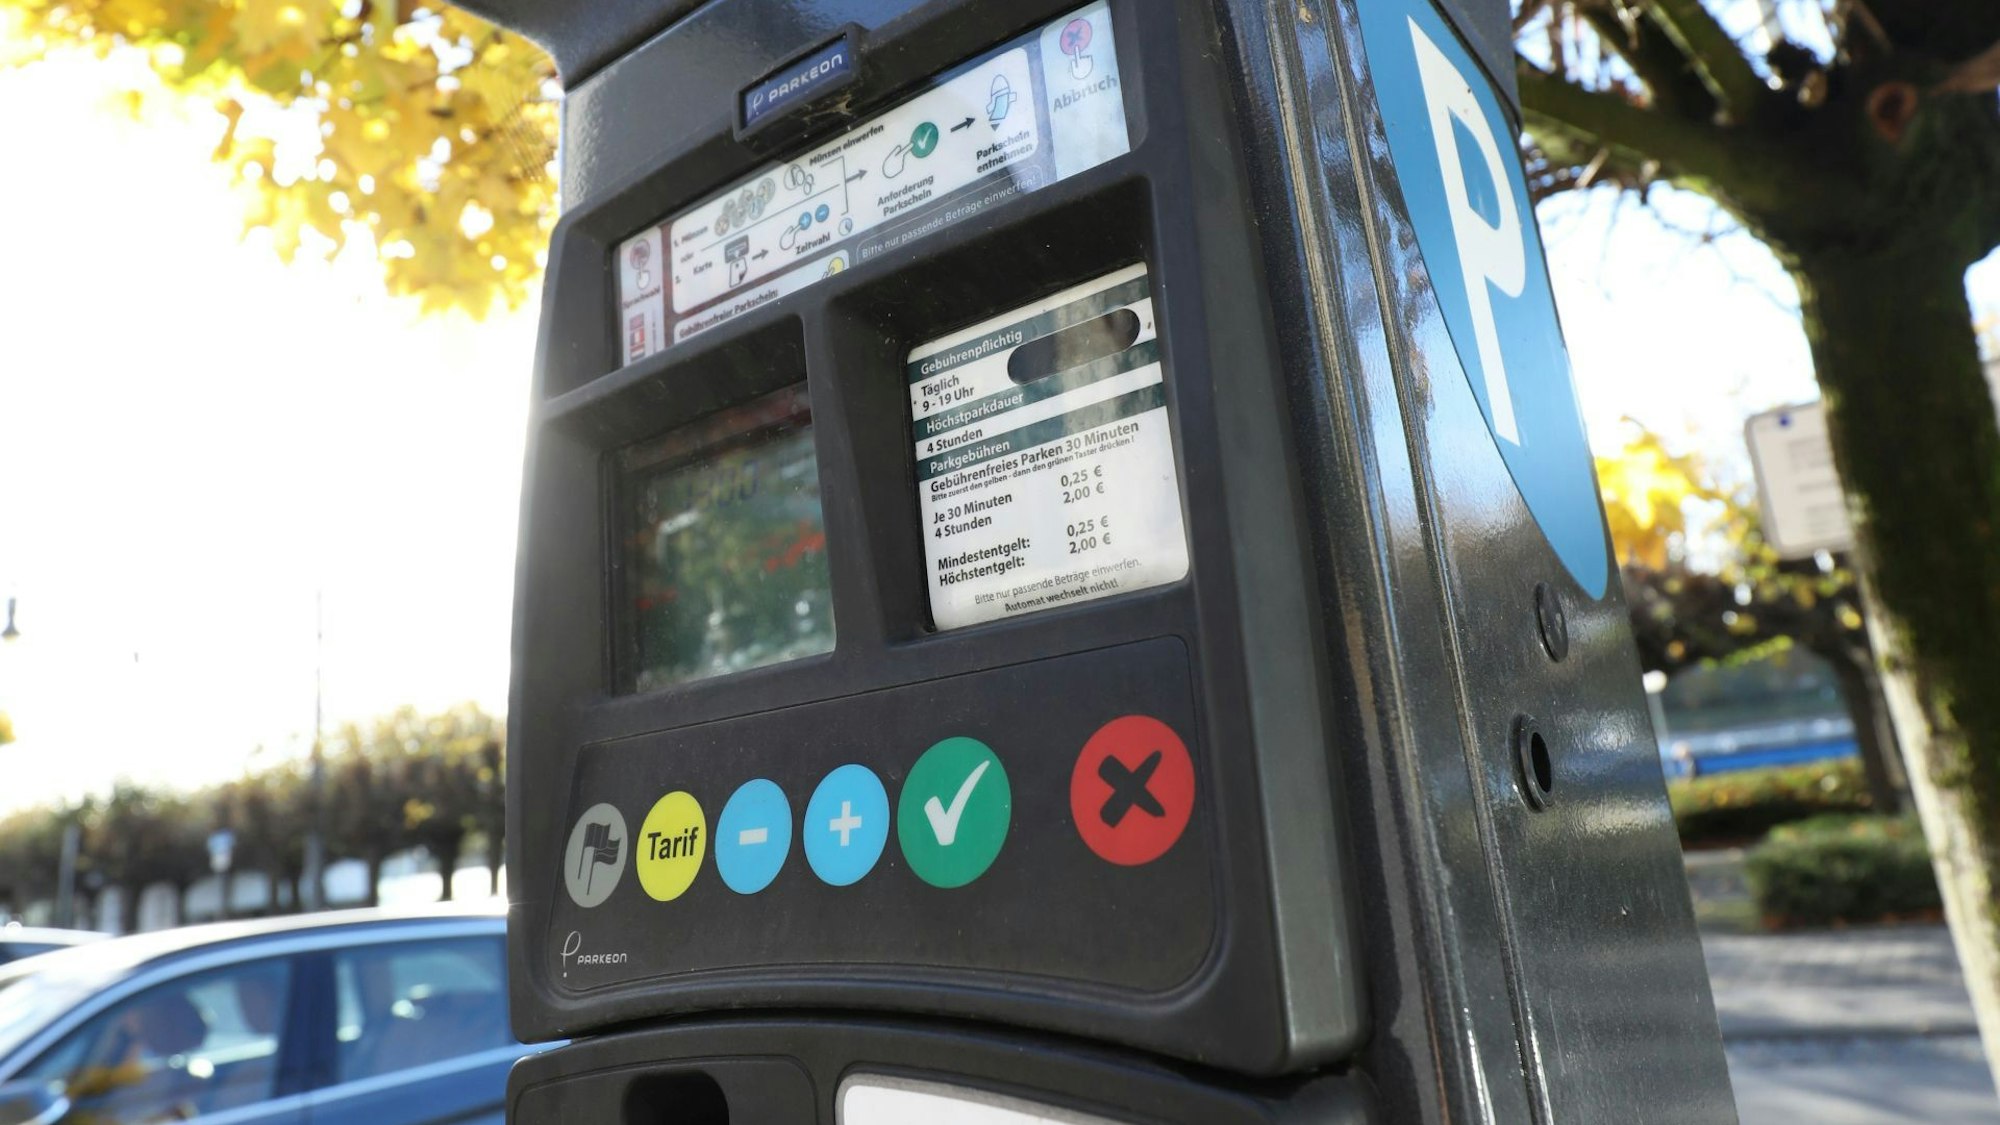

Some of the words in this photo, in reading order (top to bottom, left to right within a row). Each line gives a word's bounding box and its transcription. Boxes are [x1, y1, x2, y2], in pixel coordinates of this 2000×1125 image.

[768, 53, 843, 103] PARKEON
[1053, 74, 1118, 113] Abbruch
[843, 124, 885, 149] einwerfen
[976, 130, 1030, 160] Parkschein
[977, 143, 1033, 173] entnehmen
[877, 175, 935, 207] Anforderung
[883, 189, 932, 217] Parkschein
[862, 243, 884, 258] Bitte
[884, 237, 900, 248] nur
[901, 217, 944, 243] passende
[984, 175, 1037, 205] einwerfen!
[1406, 14, 1526, 447] P
[796, 231, 831, 254] Zeitwahl
[693, 261, 713, 275] Karte
[921, 375, 960, 397] Täglich
[923, 400, 930, 412] 9
[939, 392, 952, 406] 19
[954, 386, 975, 401] Uhr
[926, 393, 1024, 434] Höchstparkdauer
[927, 442, 934, 454] 4
[936, 428, 983, 452] Stunden
[930, 441, 1010, 474] Parkgebühren
[931, 459, 1018, 492] Gebührenfreies
[1021, 445, 1063, 466] Parken
[1066, 437, 1081, 452] 30
[1084, 422, 1139, 447] Minuten
[931, 492, 947, 502] Bitte
[948, 486, 969, 498] zuerst
[969, 482, 983, 491] den
[984, 474, 1008, 488] gelben
[1013, 468, 1031, 478] dann
[1032, 463, 1046, 472] den
[1047, 453, 1074, 469] grünen
[1075, 446, 1097, 460] Taster
[1061, 469, 1088, 487] 0,25
[1094, 465, 1102, 477] €
[1063, 486, 1090, 504] 2,00
[1096, 482, 1105, 494] €
[933, 512, 945, 524] Je
[947, 506, 961, 520] 30
[964, 493, 1013, 515] Minuten
[935, 527, 942, 539] 4
[944, 516, 992, 537] Stunden
[1067, 519, 1095, 537] 0,25
[1100, 515, 1109, 528] €
[938, 537, 1031, 571] Mindestentgelt:
[1069, 536, 1097, 554] 2,00
[1102, 532, 1111, 545] €
[940, 556, 1025, 587] Höchstentgelt:
[974, 594, 995, 605] Bitte
[996, 589, 1011, 599] nur
[1012, 577, 1054, 598] passende
[1054, 570, 1090, 587] Beträge
[1005, 597, 1046, 612] Automat
[1046, 586, 1089, 603] wechselt
[1090, 578, 1119, 592] nicht!
[647, 826, 700, 861] Tarif
[577, 953, 628, 965] PARKEON
